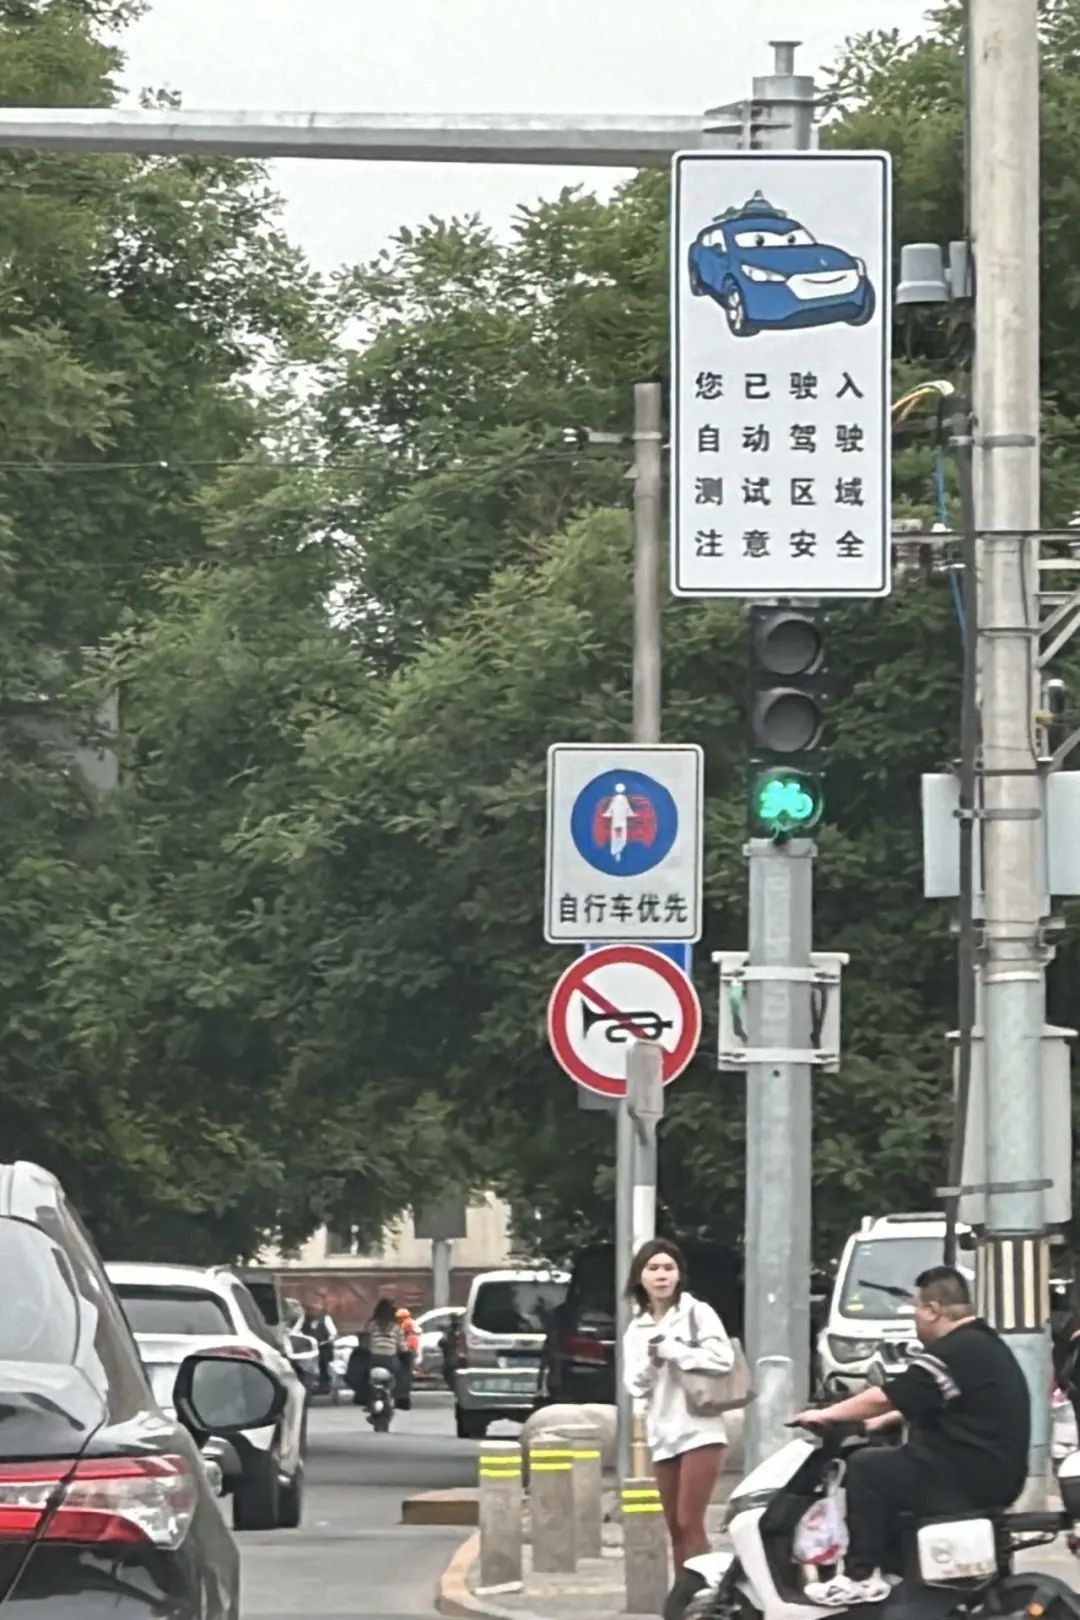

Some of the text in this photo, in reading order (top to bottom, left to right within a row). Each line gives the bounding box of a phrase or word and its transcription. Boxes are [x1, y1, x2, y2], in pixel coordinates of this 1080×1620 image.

[695, 371, 864, 400] 您已驶入
[694, 423, 864, 453] 自动驾驶
[694, 476, 865, 507] 测试区域
[694, 529, 864, 558] 注意安全
[559, 892, 688, 923] 自行车优先
